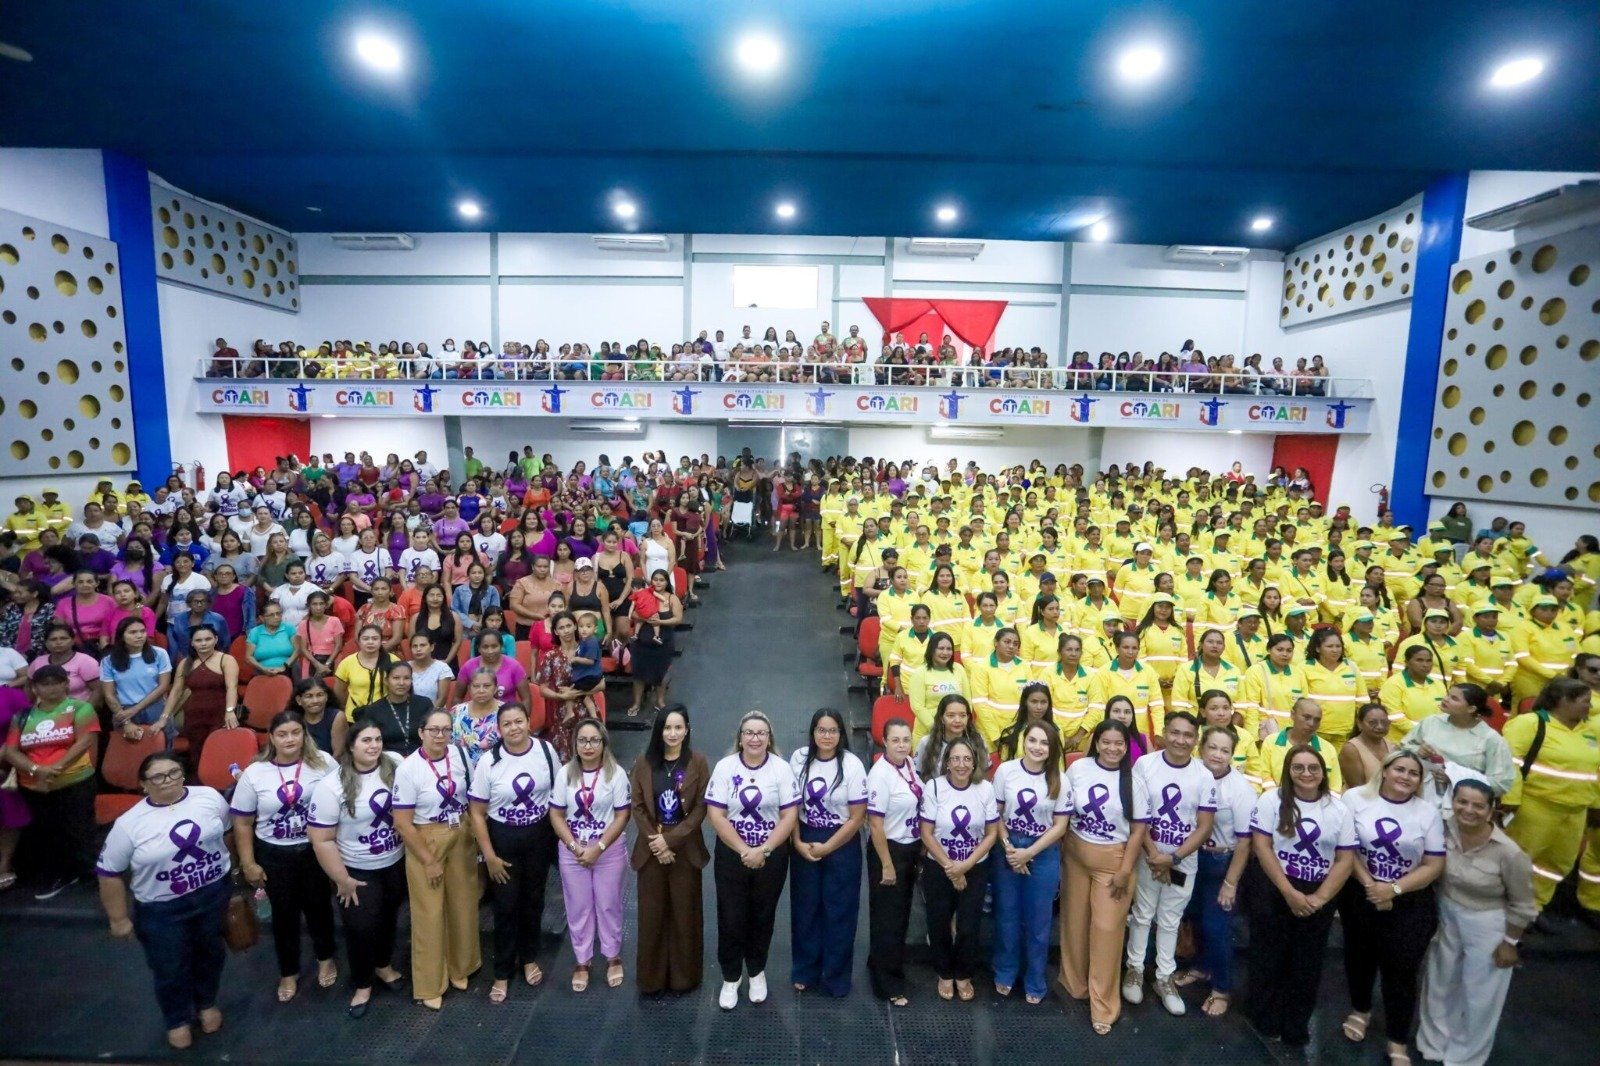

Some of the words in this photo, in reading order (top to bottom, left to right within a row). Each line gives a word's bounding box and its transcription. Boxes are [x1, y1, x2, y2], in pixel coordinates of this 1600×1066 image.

[498, 804, 546, 821] agosto
[747, 832, 769, 845] lilá
[156, 850, 221, 882] agosto
[1278, 850, 1330, 868] agosto
[1360, 847, 1412, 868] agosto
